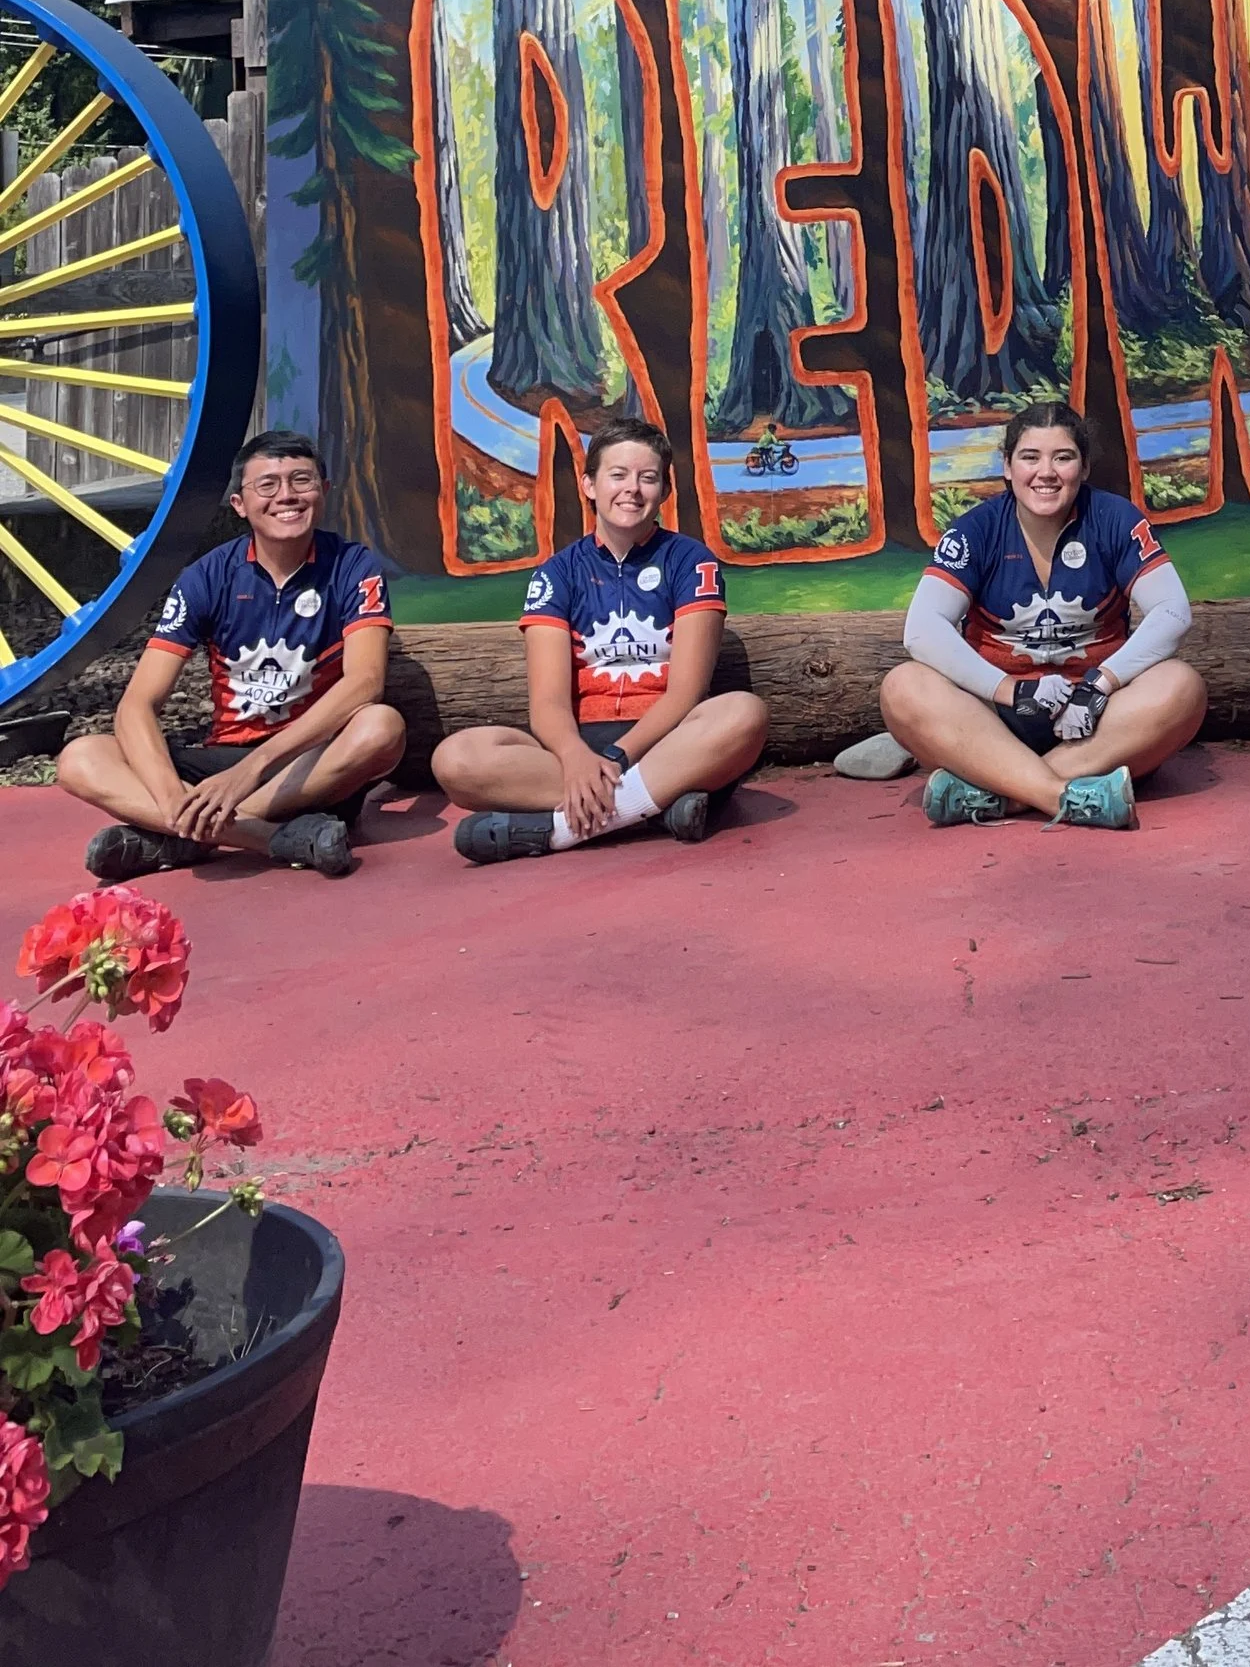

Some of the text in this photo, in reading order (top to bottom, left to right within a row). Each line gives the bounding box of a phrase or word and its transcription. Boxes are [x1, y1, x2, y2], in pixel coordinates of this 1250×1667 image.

[939, 537, 962, 559] 15
[1130, 518, 1163, 562] I
[695, 561, 720, 597] I
[593, 642, 658, 659] ILLINI
[240, 670, 301, 687] ILLINI
[243, 687, 288, 703] 4000
